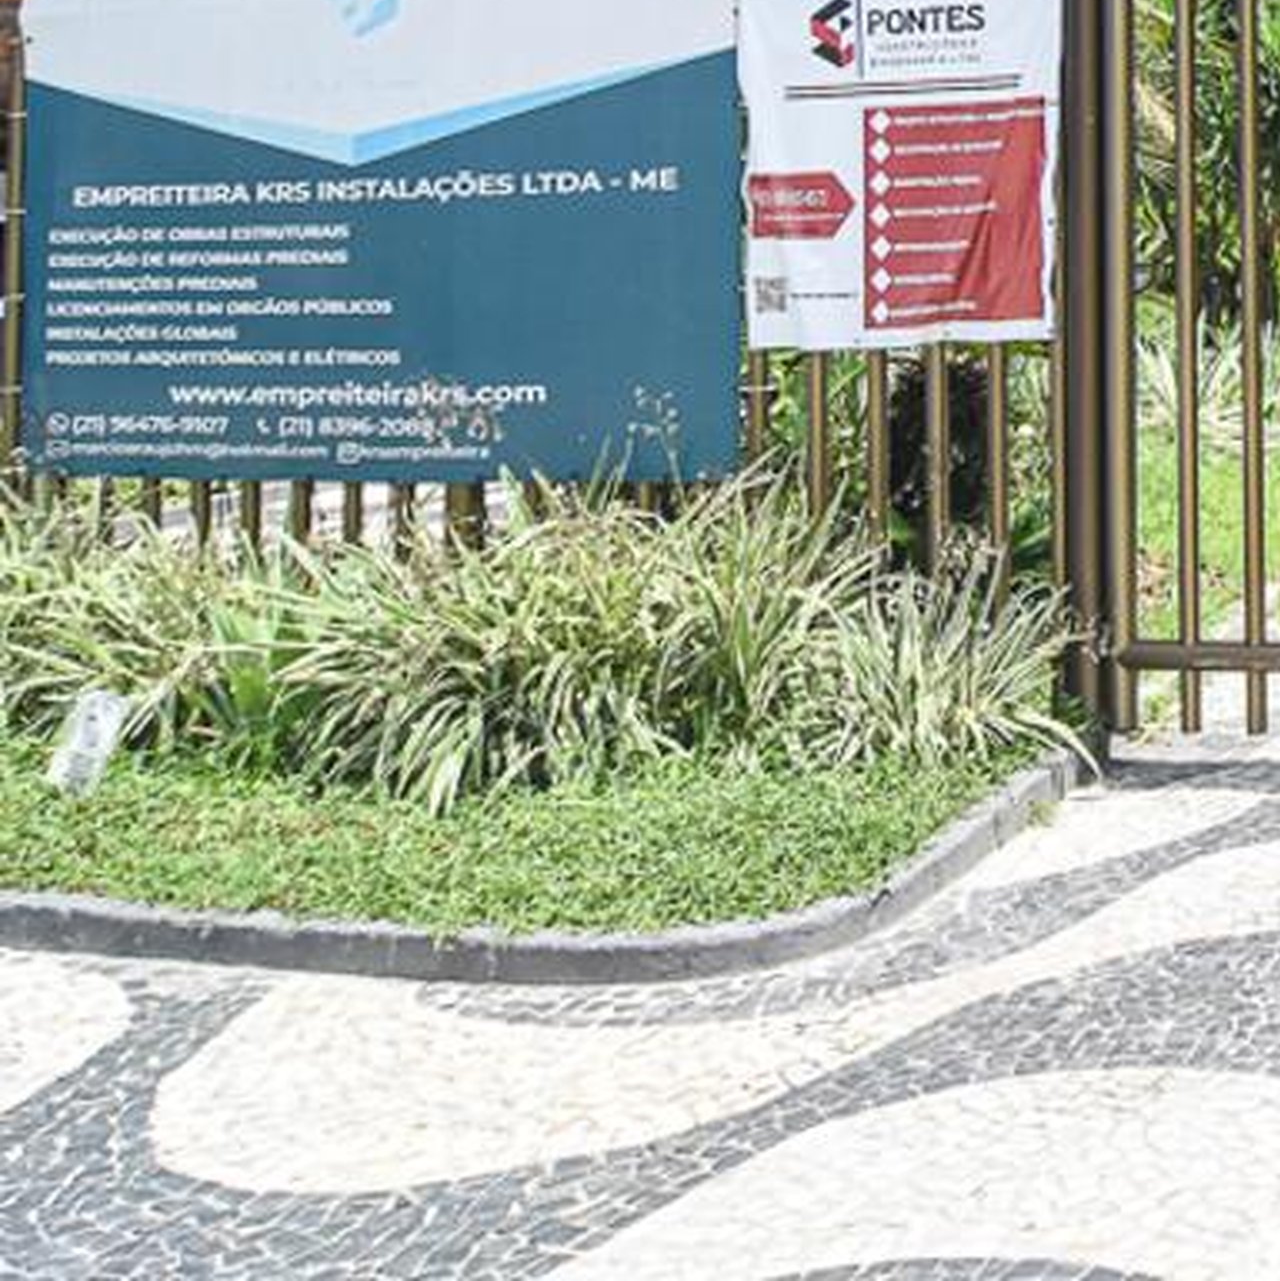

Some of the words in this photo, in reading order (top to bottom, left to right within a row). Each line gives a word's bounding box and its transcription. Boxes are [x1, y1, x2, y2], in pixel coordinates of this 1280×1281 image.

[867, 4, 985, 36] PONTES
[73, 182, 249, 207] EMPREITEIRA
[257, 180, 311, 203] KRS
[318, 171, 515, 203] INSTALAÇÕES
[522, 172, 603, 195] LTDA
[630, 168, 678, 191] ME
[168, 381, 546, 409] www.empreiteirakrs.com
